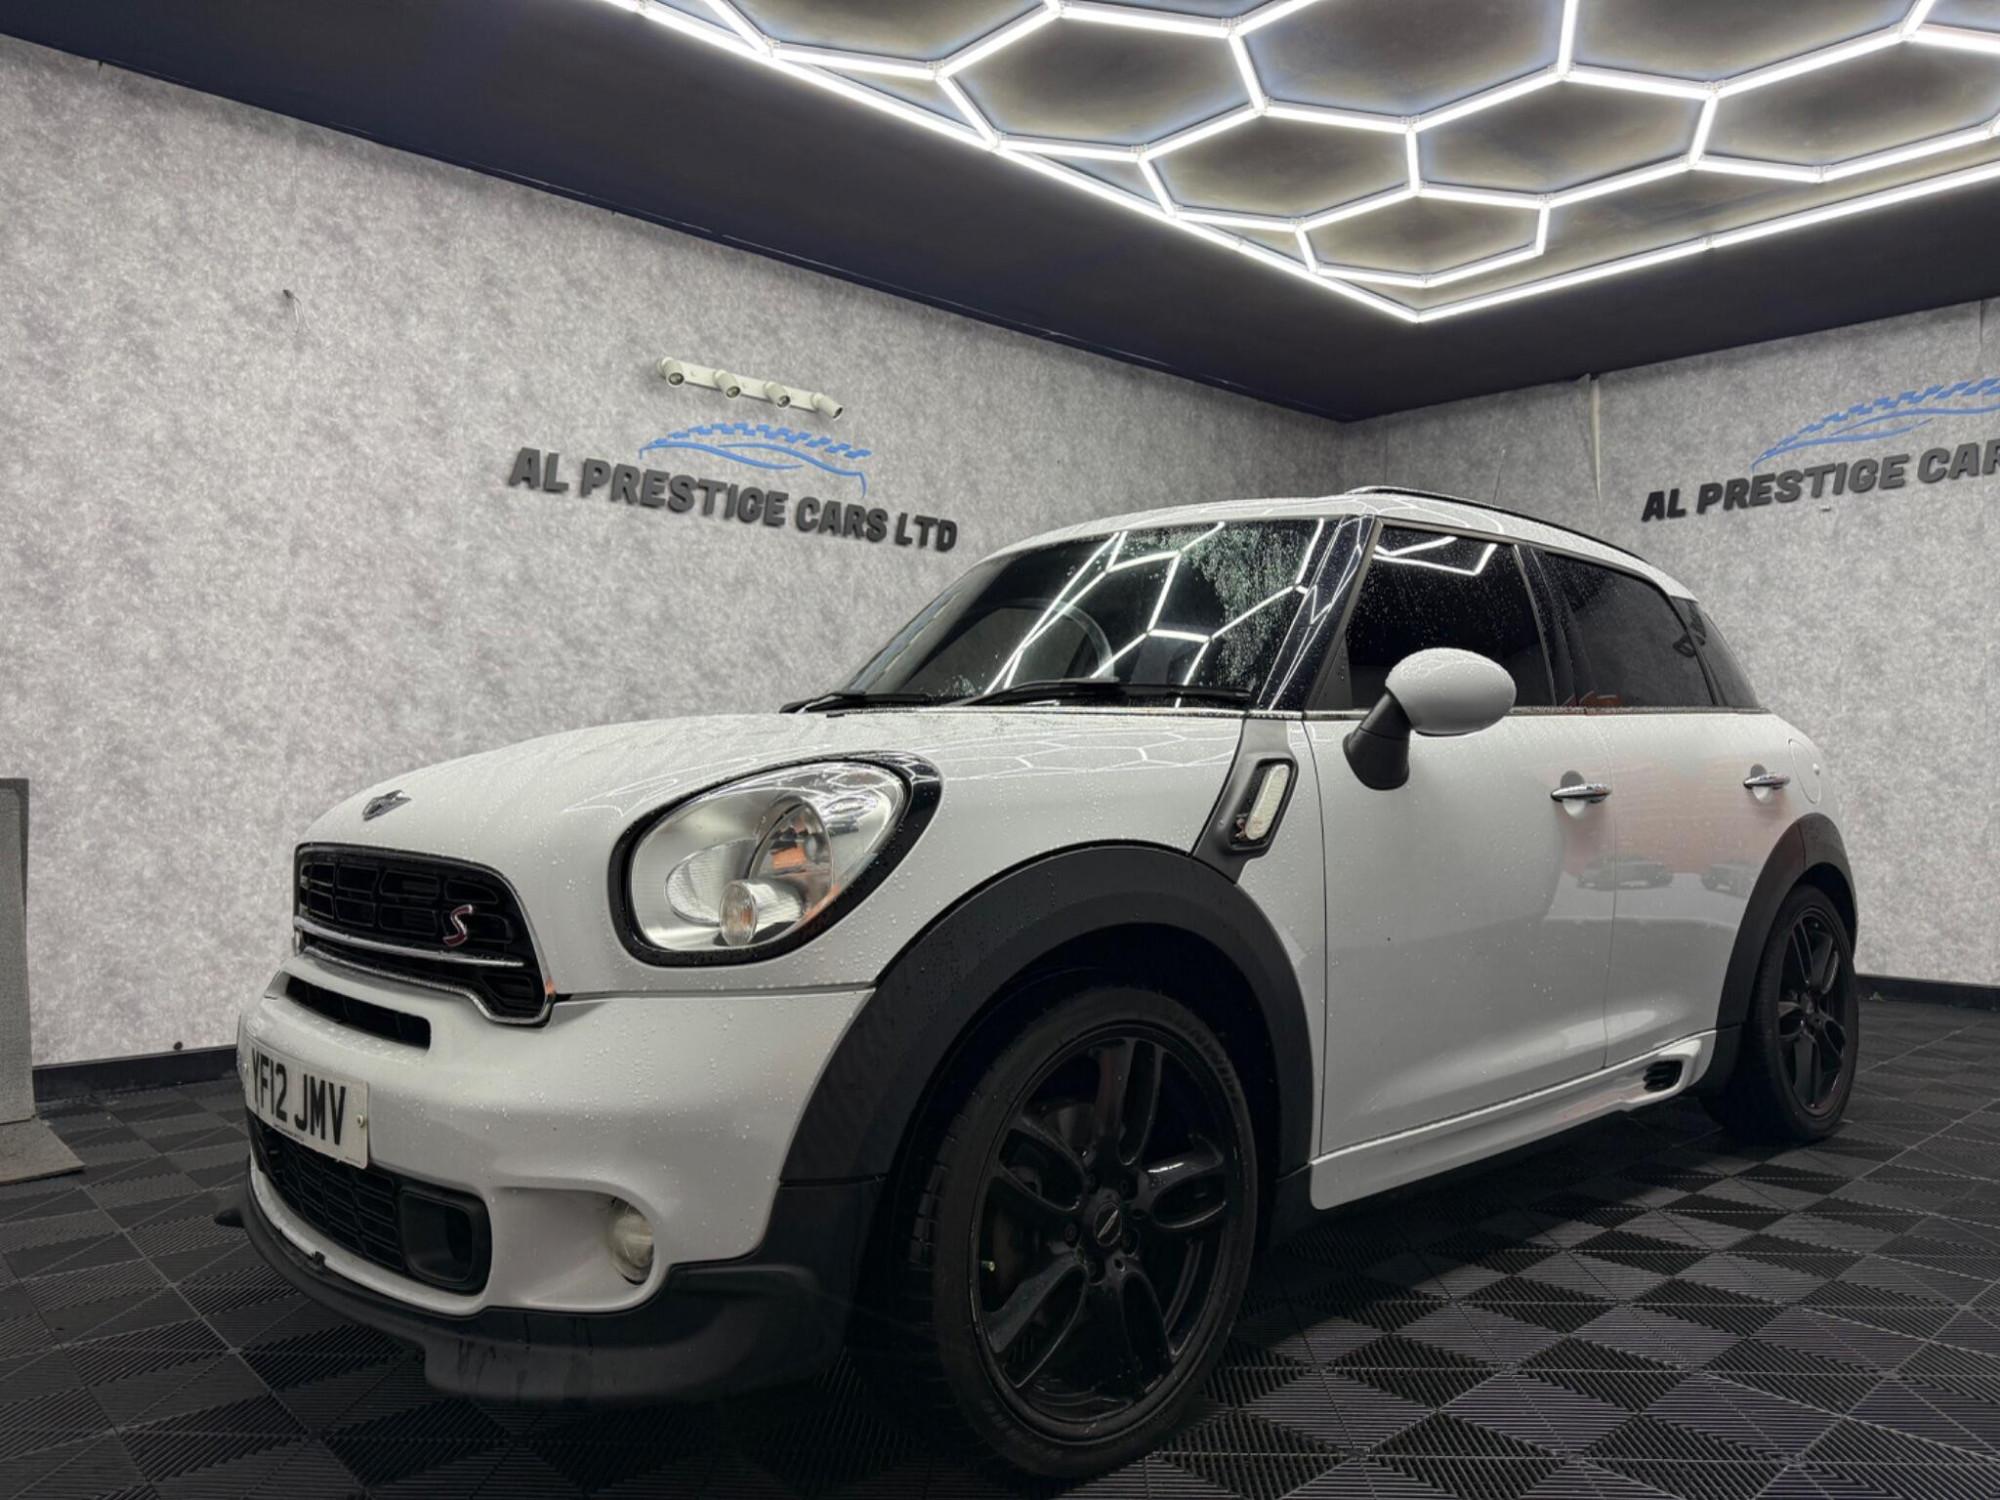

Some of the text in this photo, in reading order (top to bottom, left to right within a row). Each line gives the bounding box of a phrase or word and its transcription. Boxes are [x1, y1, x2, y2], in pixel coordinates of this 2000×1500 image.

[508, 446, 958, 552] AL PRESTIGE CARS LTD
[1641, 488, 1686, 522] AL
[1696, 454, 1909, 515] PRESTIGE
[443, 904, 473, 947] S
[252, 1047, 346, 1146] YF12 JMV
